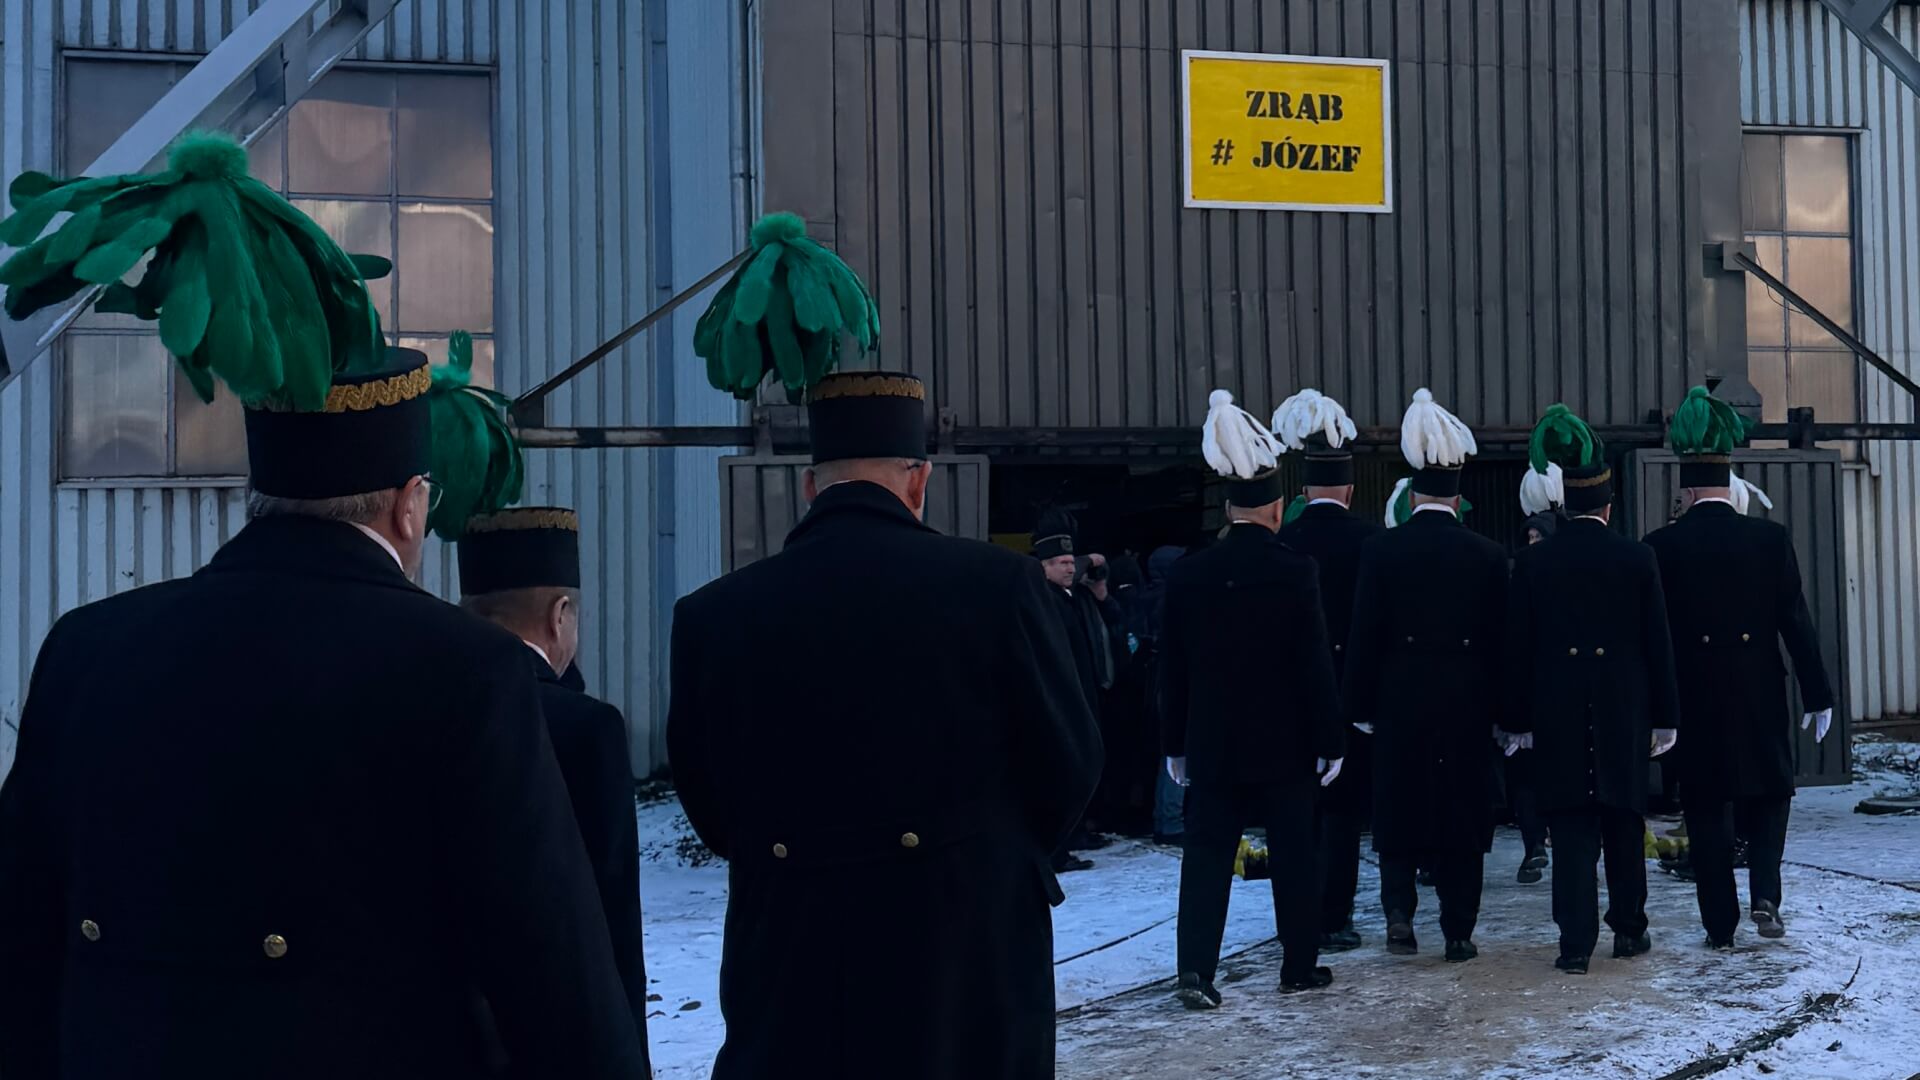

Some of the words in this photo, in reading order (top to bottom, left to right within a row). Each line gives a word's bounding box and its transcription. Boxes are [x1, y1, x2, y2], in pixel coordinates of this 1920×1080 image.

[1246, 90, 1343, 124] ZRĄB
[1211, 138, 1235, 166] #
[1252, 136, 1362, 172] JÓZEF
